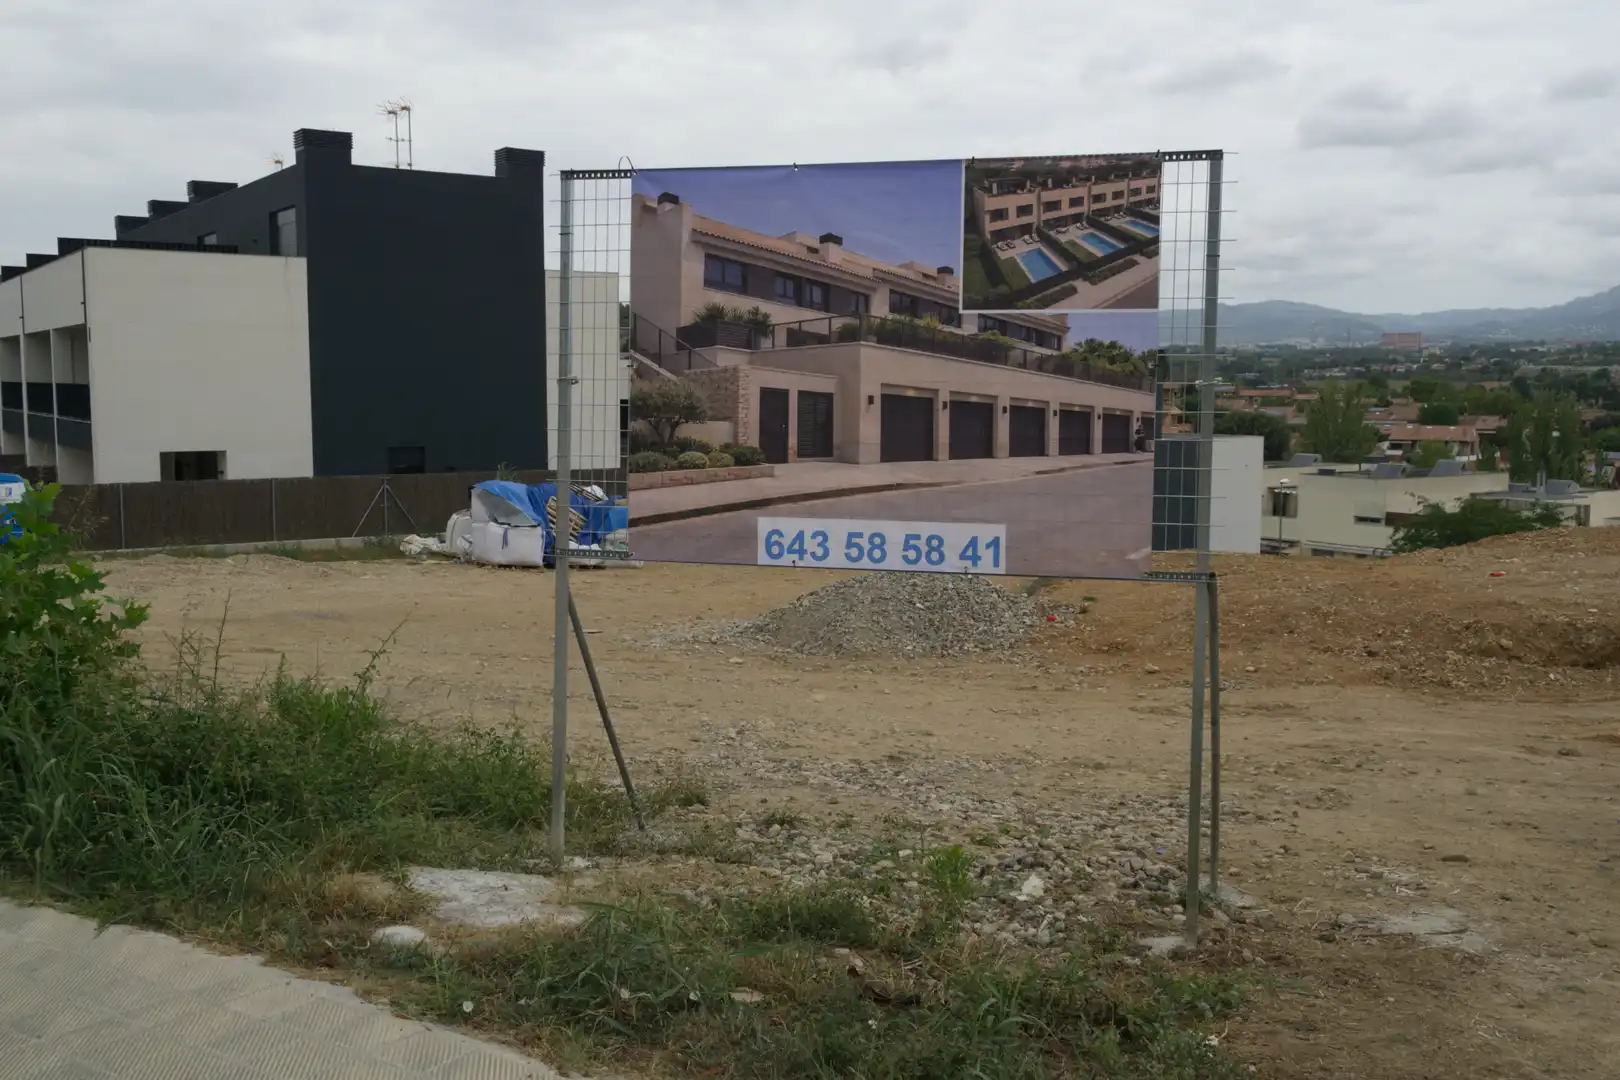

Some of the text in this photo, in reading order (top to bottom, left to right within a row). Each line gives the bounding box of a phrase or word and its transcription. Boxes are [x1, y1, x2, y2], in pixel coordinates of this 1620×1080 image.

[765, 529, 1000, 568] 643 58 58 41
